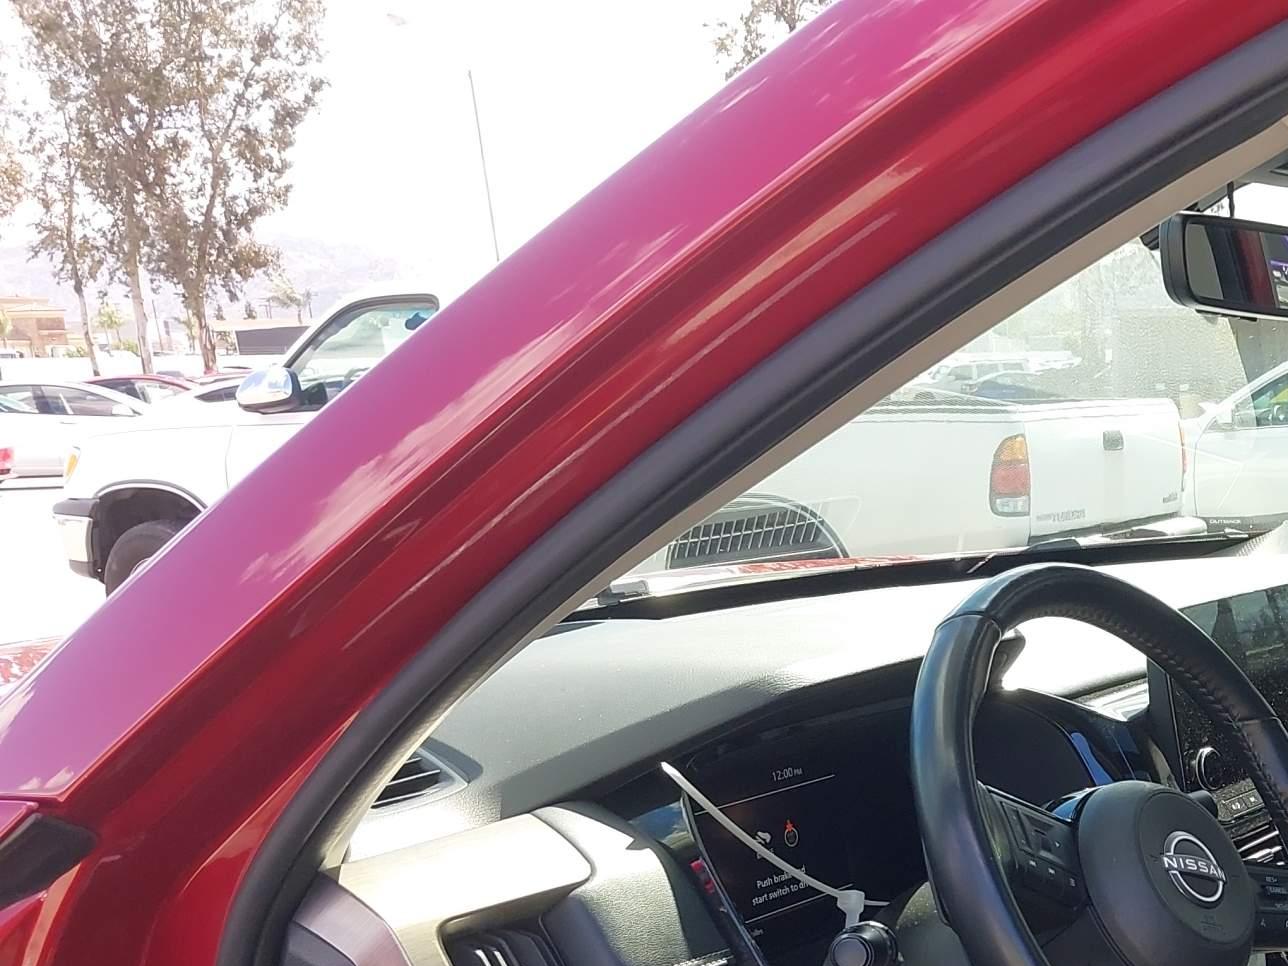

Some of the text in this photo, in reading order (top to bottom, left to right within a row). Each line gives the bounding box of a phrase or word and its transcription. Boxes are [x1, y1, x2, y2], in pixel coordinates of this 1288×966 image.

[772, 767, 794, 782] 12:00
[1163, 856, 1226, 881] NISSAN
[757, 877, 773, 889] Push
[752, 893, 769, 906] start
[769, 887, 790, 900] switch
[790, 883, 798, 892] to
